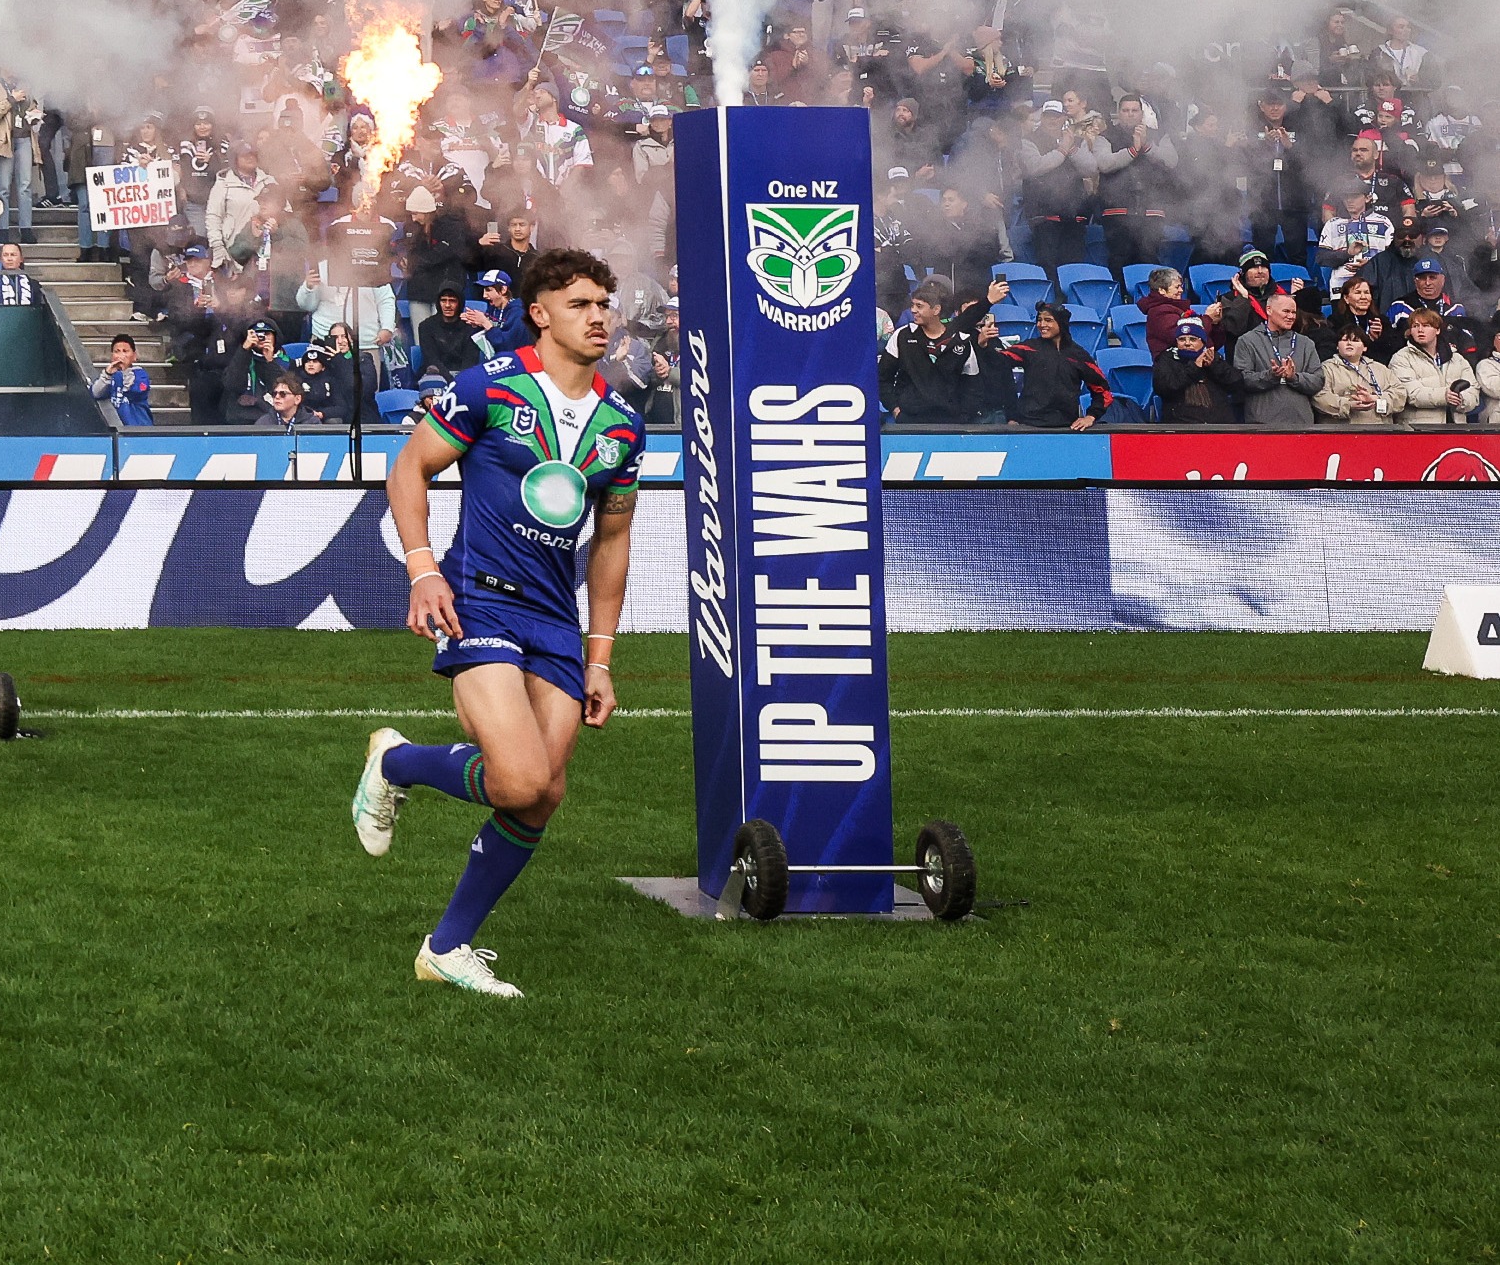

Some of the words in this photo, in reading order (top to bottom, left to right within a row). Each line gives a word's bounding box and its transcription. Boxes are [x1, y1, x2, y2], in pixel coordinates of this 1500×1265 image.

[93, 171, 105, 186] OH
[157, 168, 169, 178] THE
[768, 180, 807, 198] One
[810, 180, 838, 198] NZ
[103, 184, 149, 206] TIGERS
[157, 188, 172, 199] ARE
[97, 213, 106, 224] IN
[109, 201, 173, 226] TROUBLE
[756, 294, 852, 332] WARRIORS
[749, 385, 869, 557] WAHS
[687, 330, 733, 678] Warriors
[512, 522, 574, 551] one.nz
[755, 574, 873, 685] THE
[759, 702, 876, 782] UP
